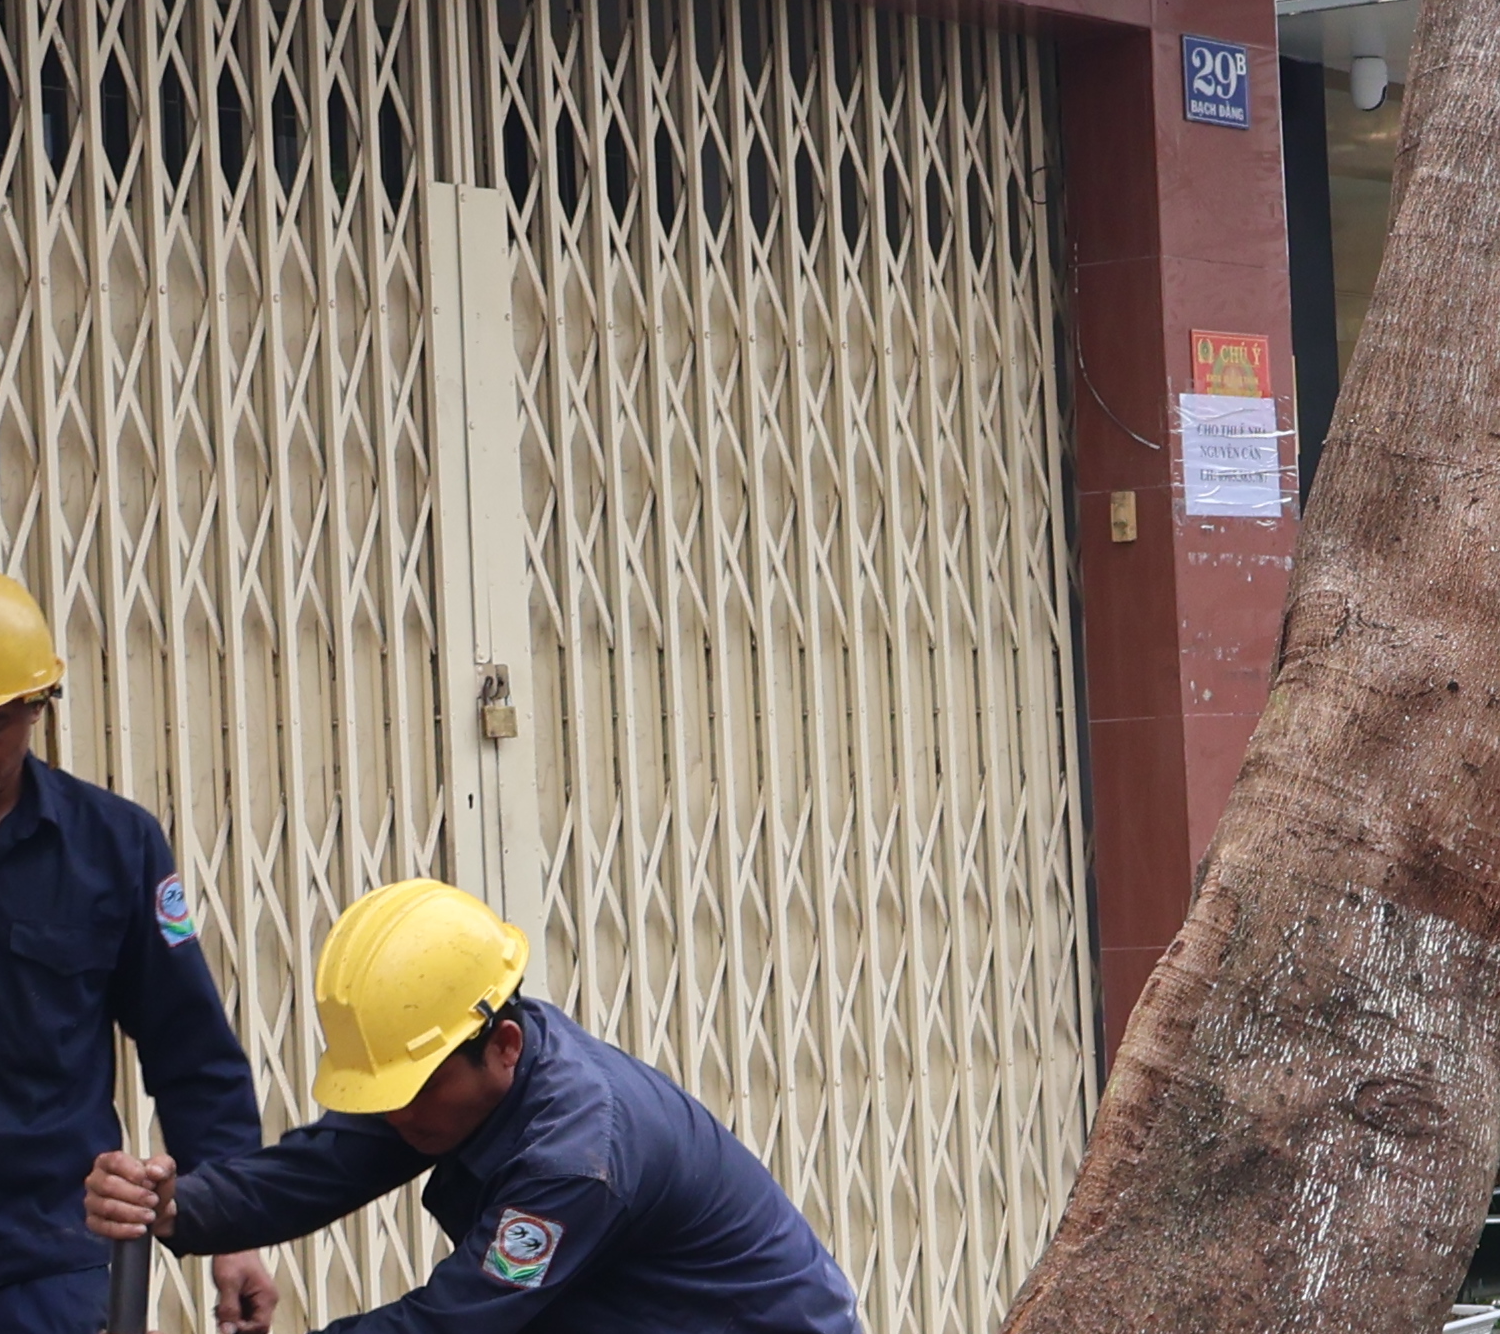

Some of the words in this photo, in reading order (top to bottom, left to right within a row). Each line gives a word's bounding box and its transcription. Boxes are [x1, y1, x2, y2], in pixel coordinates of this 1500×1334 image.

[1191, 99, 1217, 117] BẠCH
[1220, 342, 1247, 364] CHÚ
[1252, 342, 1261, 366] Ý
[1197, 423, 1219, 437] CHO
[1200, 443, 1239, 459] NGUYÊN
